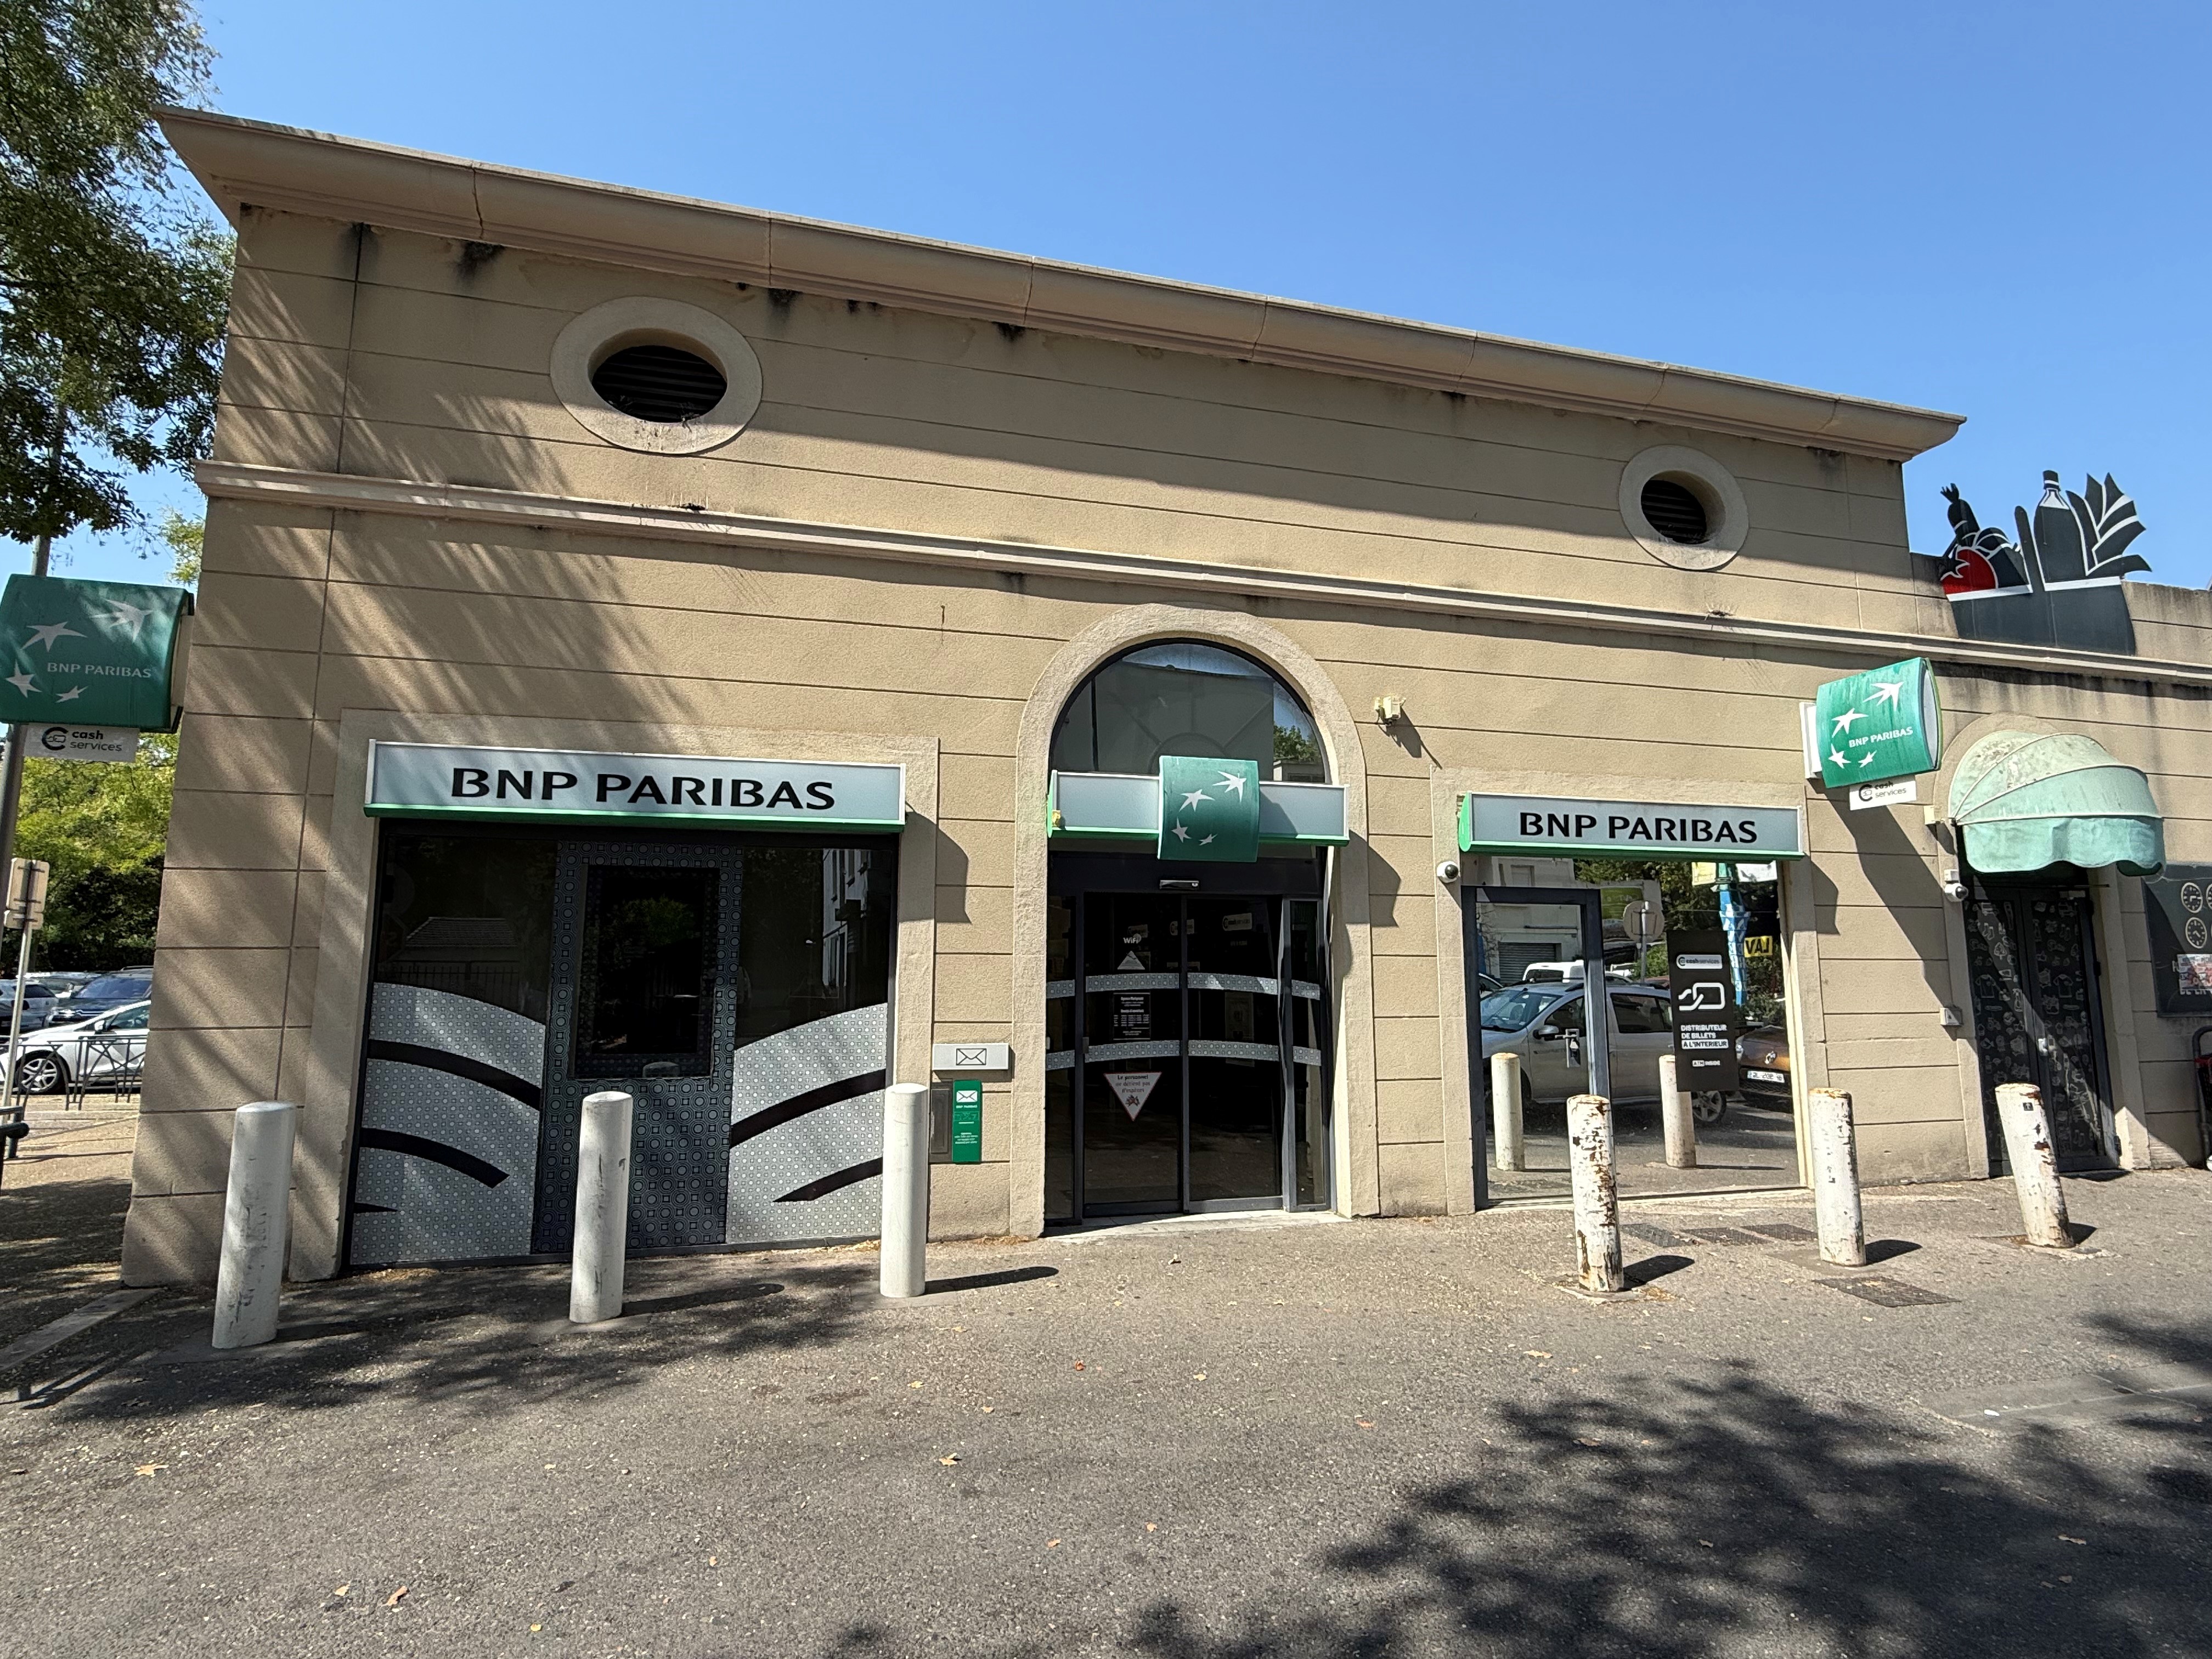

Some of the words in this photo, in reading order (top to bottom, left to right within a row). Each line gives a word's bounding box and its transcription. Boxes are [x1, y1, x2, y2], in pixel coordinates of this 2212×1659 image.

[47, 662, 81, 673] BNP
[84, 664, 151, 678] PARIBAS
[72, 730, 104, 740] cash
[1849, 737, 1869, 748] BNP
[1870, 726, 1914, 743] PARIBAS
[70, 741, 123, 752] services
[451, 767, 578, 801] BNP
[596, 772, 835, 810] PARIBAS
[1874, 780, 1894, 789] cash
[1875, 788, 1907, 798] services
[1520, 812, 1597, 838] BNP
[1609, 815, 1758, 843] PARIBAS
